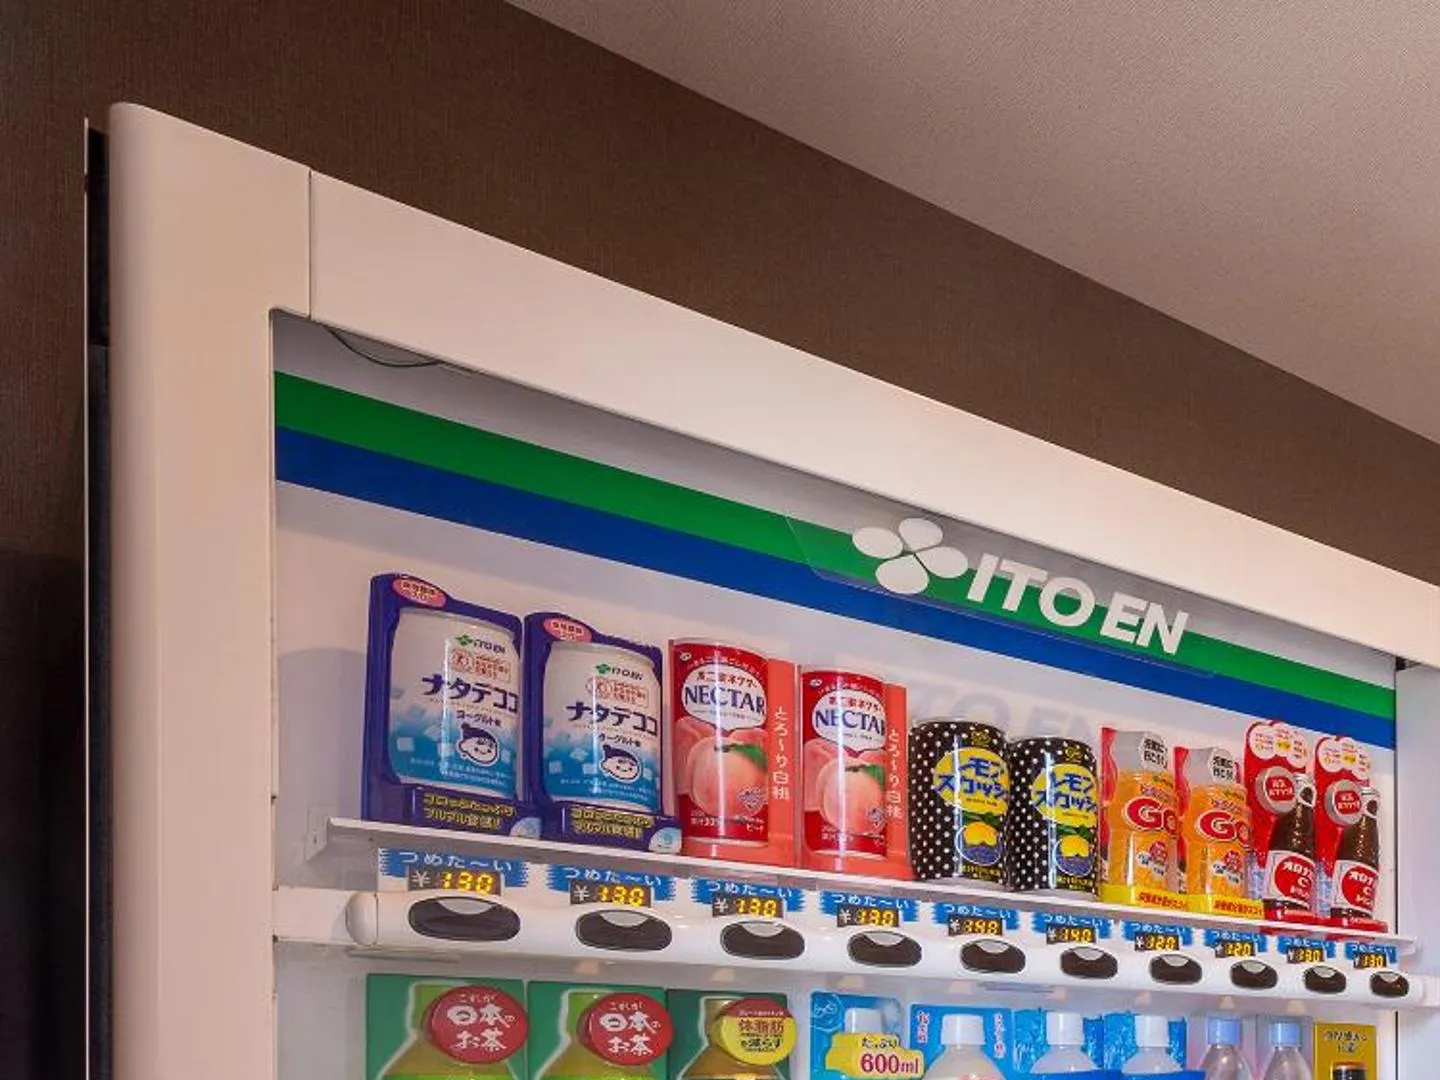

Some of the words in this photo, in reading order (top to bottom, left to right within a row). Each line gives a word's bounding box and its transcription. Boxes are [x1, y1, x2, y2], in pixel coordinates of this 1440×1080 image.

[966, 552, 1095, 627] ITO
[1099, 591, 1189, 655] EN
[422, 674, 519, 714] ナタデココ
[684, 685, 765, 716] NECTAR
[566, 702, 658, 737] ナタデココ
[815, 709, 885, 736] NECTA
[456, 1030, 507, 1052] お茶
[608, 1033, 653, 1056] お茶
[860, 1052, 920, 1075] 600ml
